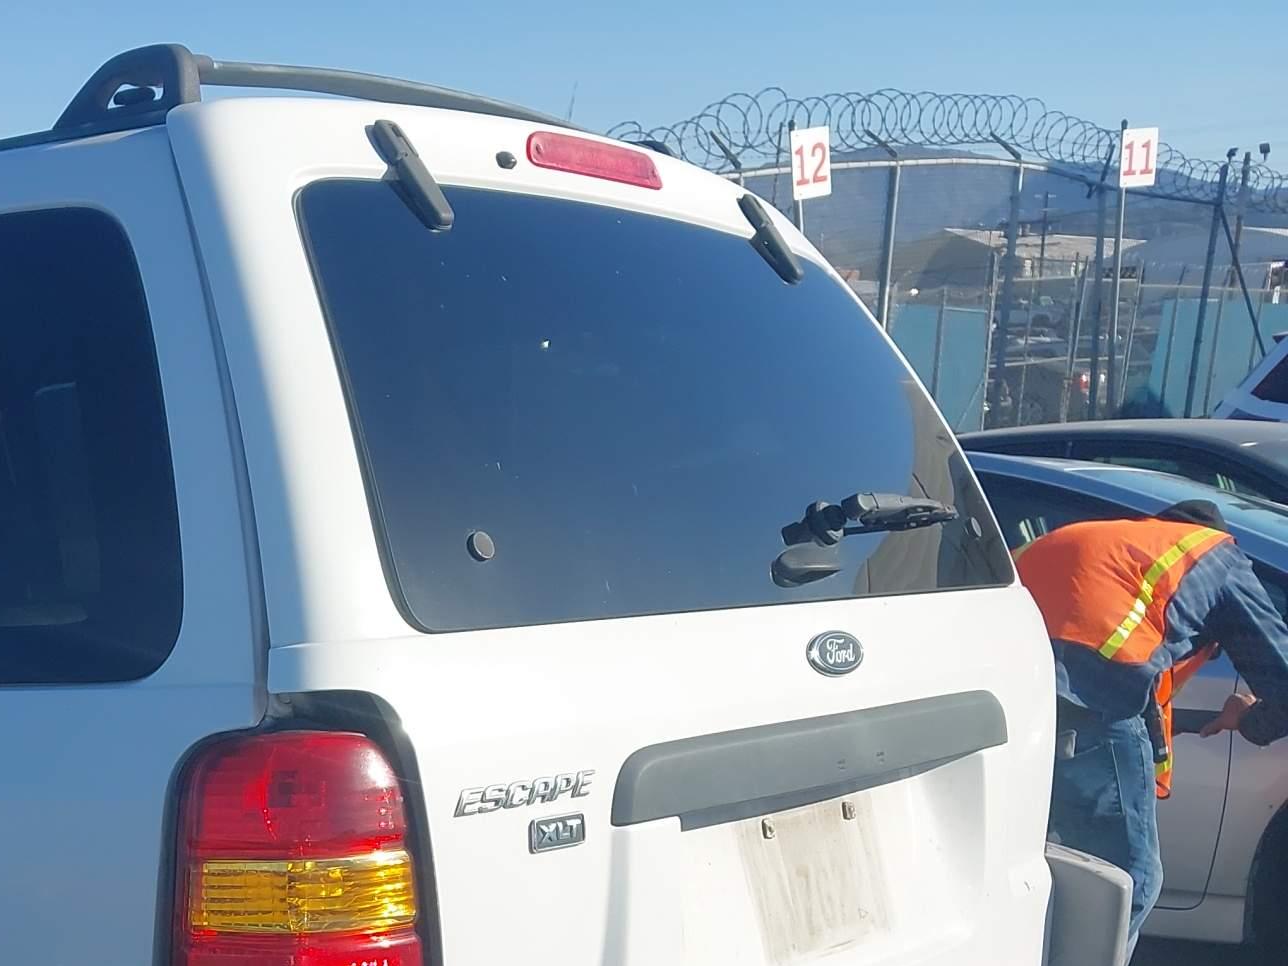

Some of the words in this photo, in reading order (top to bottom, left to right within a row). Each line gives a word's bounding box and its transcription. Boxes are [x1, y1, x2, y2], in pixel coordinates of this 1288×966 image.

[795, 142, 827, 186] 12
[1123, 139, 1153, 176] 11
[826, 638, 855, 664] Ford
[453, 769, 595, 817] ESCAPE
[538, 818, 582, 845] XLT
